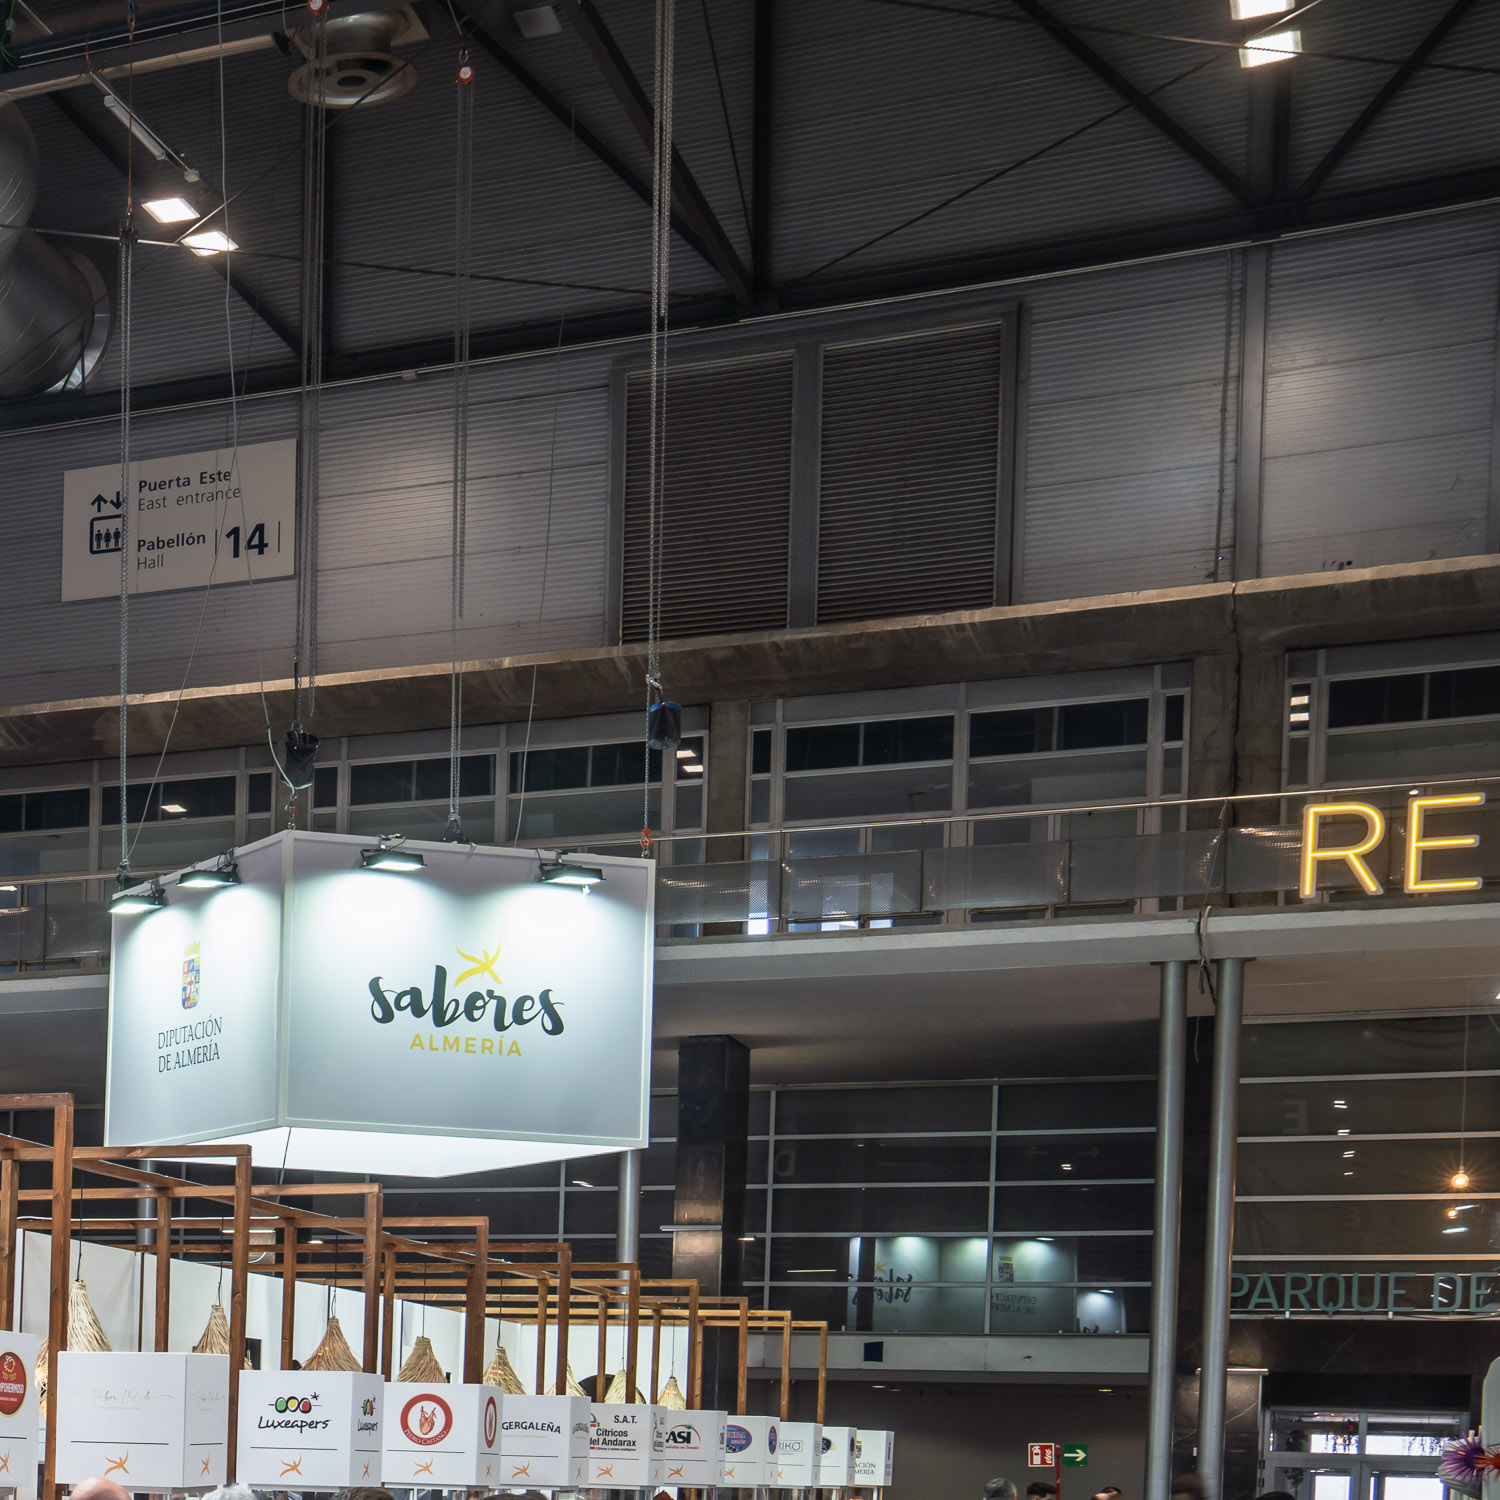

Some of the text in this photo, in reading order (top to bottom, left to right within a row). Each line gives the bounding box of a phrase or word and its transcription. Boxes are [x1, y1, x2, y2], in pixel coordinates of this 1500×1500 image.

[138, 470, 231, 493] Puerta Este
[138, 487, 241, 511] East entrance
[137, 523, 269, 559] Pabellón 14
[137, 554, 164, 571] Hall
[1300, 792, 1486, 898] RE
[158, 1014, 222, 1050] DIPUTACIÓN
[158, 1039, 220, 1073] DE ALMERÍA
[409, 1033, 523, 1057] ALMERÍA
[1230, 1272, 1417, 1317] PARQUE
[258, 1416, 330, 1433] Luxeapers
[501, 1421, 561, 1434] GERGALEÑA
[613, 1415, 637, 1424] S.A.T.
[596, 1428, 628, 1438] Cítricos
[600, 1437, 637, 1447] Andarax
[666, 1431, 691, 1444] ASI
